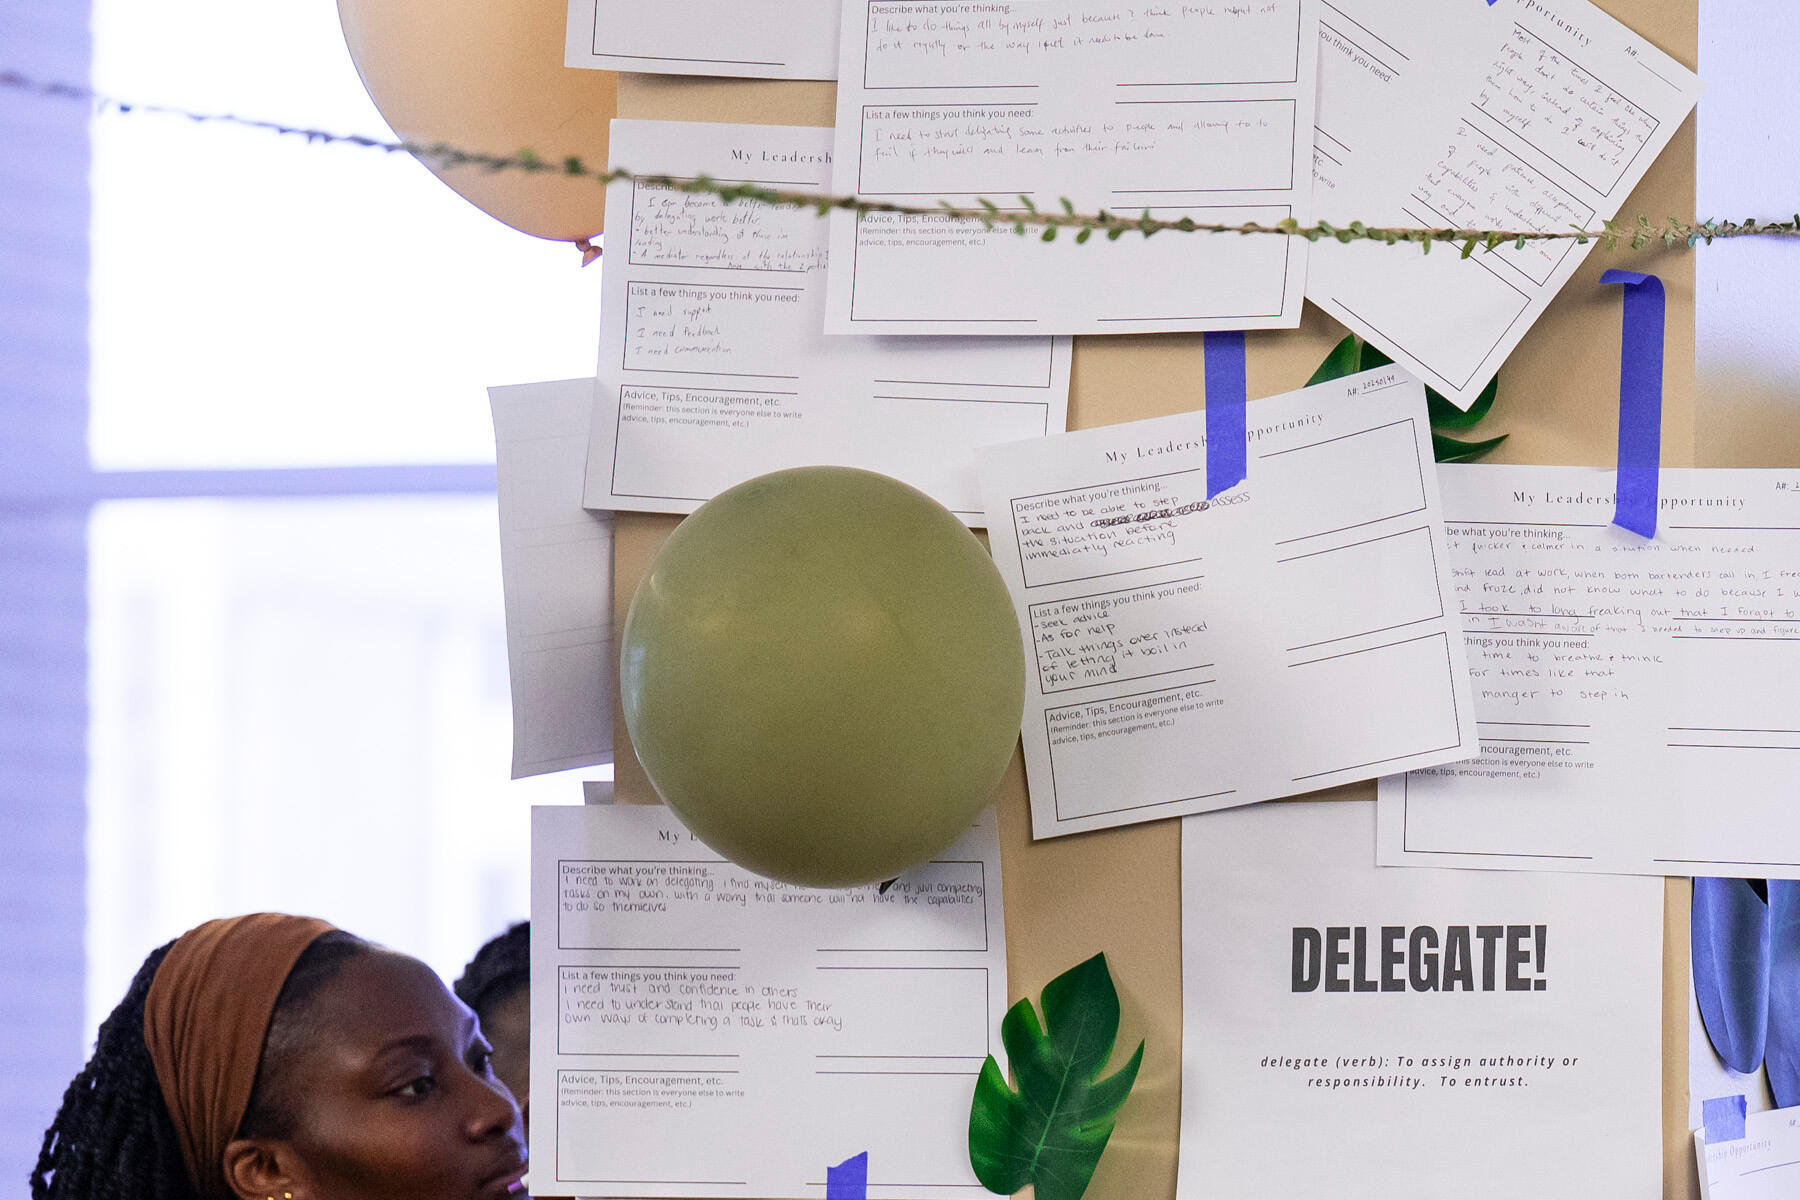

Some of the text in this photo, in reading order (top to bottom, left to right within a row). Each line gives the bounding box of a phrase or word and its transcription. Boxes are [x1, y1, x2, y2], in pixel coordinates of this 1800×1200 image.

[1517, 0, 1592, 47] portunity
[1332, 38, 1354, 59] think
[1351, 54, 1370, 69] you
[1368, 64, 1393, 85] need:
[731, 148, 832, 165] My Leadersh
[858, 238, 986, 248] advice, tips, encouragement, etc.)
[631, 285, 800, 304] List a few things you think you need:
[1246, 413, 1324, 441] pportunity
[1105, 434, 1208, 464] My Leaders
[1015, 498, 1061, 513] Describe
[1061, 493, 1087, 505] what
[1088, 488, 1120, 504] you're
[1513, 491, 1616, 507] My Leaders
[1660, 495, 1745, 511] pportunity
[562, 864, 607, 876] Describe
[608, 864, 634, 876] what
[635, 865, 667, 878] you're
[1291, 924, 1547, 993] DELEGATE!
[1260, 1054, 1579, 1071] delegate (verb): To assign authority or
[1307, 1074, 1528, 1091] responsibility. To entrust.
